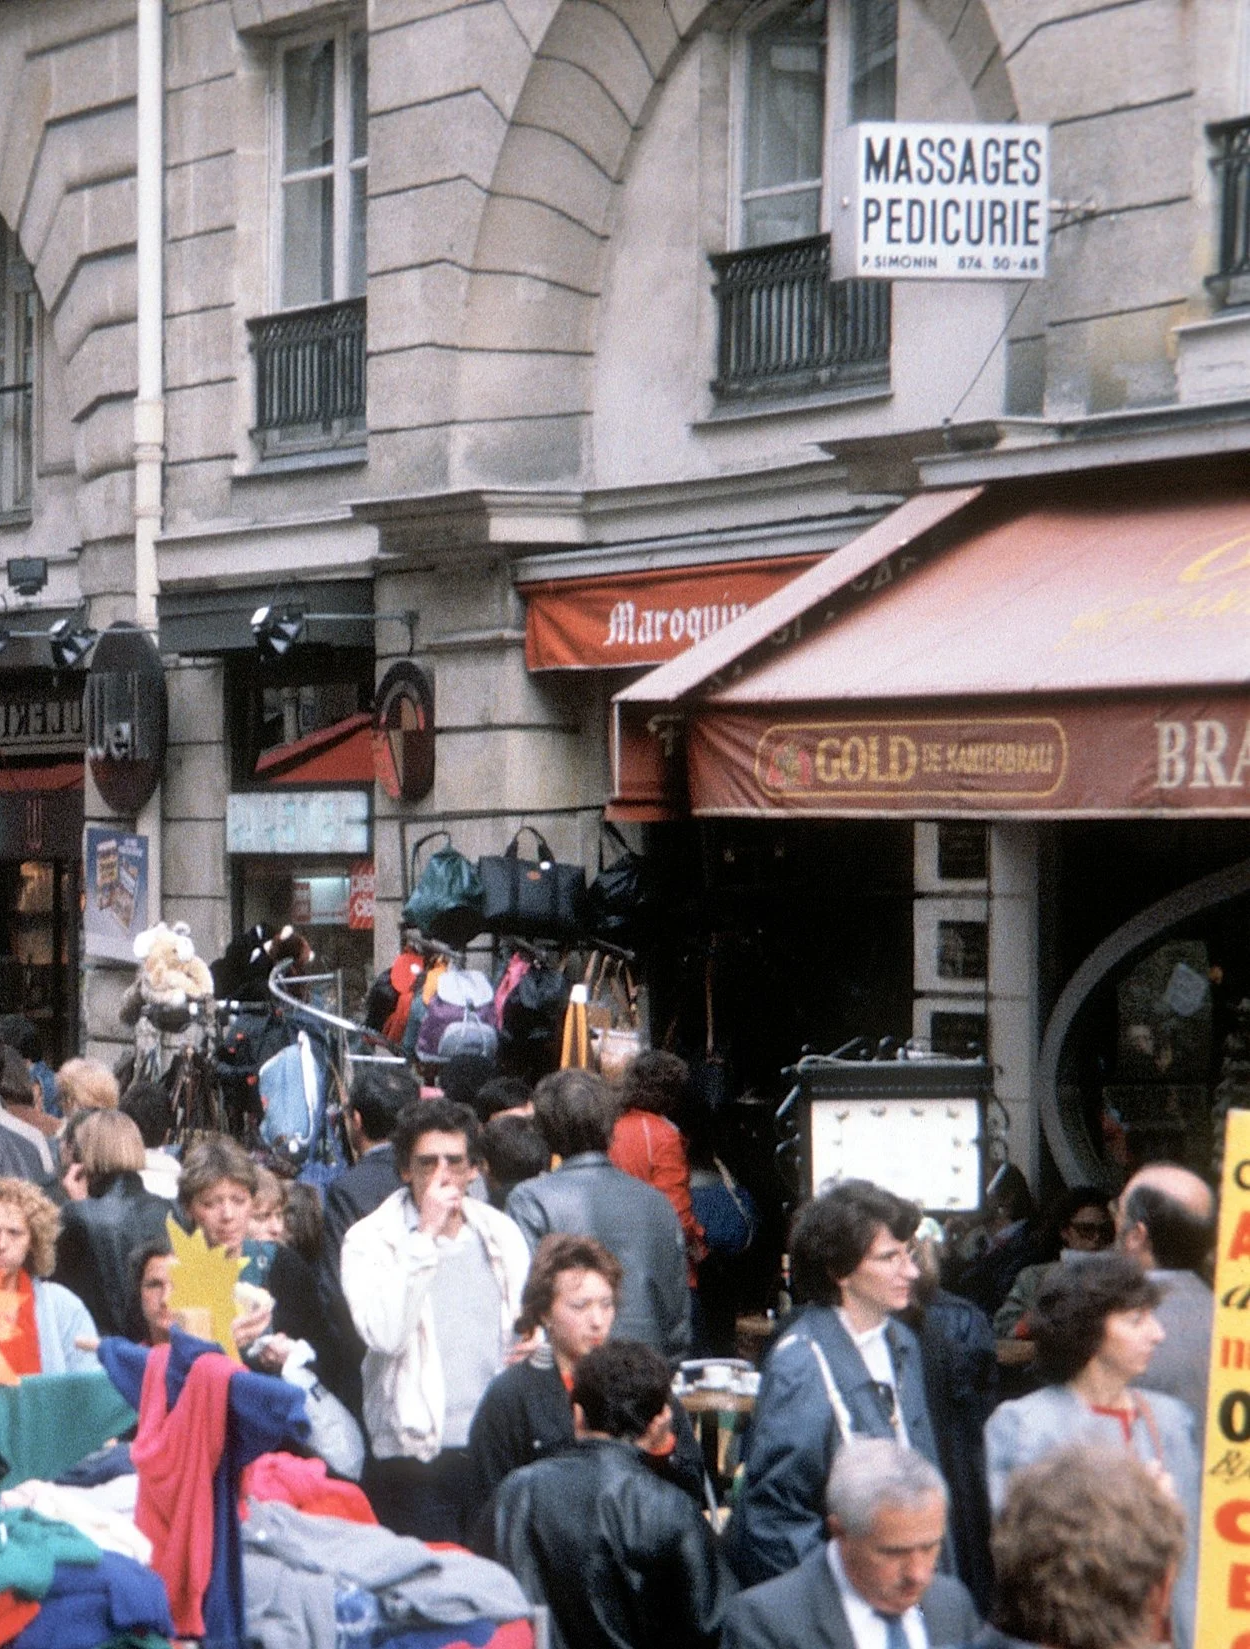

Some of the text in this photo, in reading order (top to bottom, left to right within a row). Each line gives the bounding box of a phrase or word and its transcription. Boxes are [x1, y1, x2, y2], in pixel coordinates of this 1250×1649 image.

[863, 136, 1042, 185] MASSAGES
[862, 197, 1041, 246] PEDICURIE
[815, 734, 918, 784] GOLD
[922, 742, 942, 772] DE
